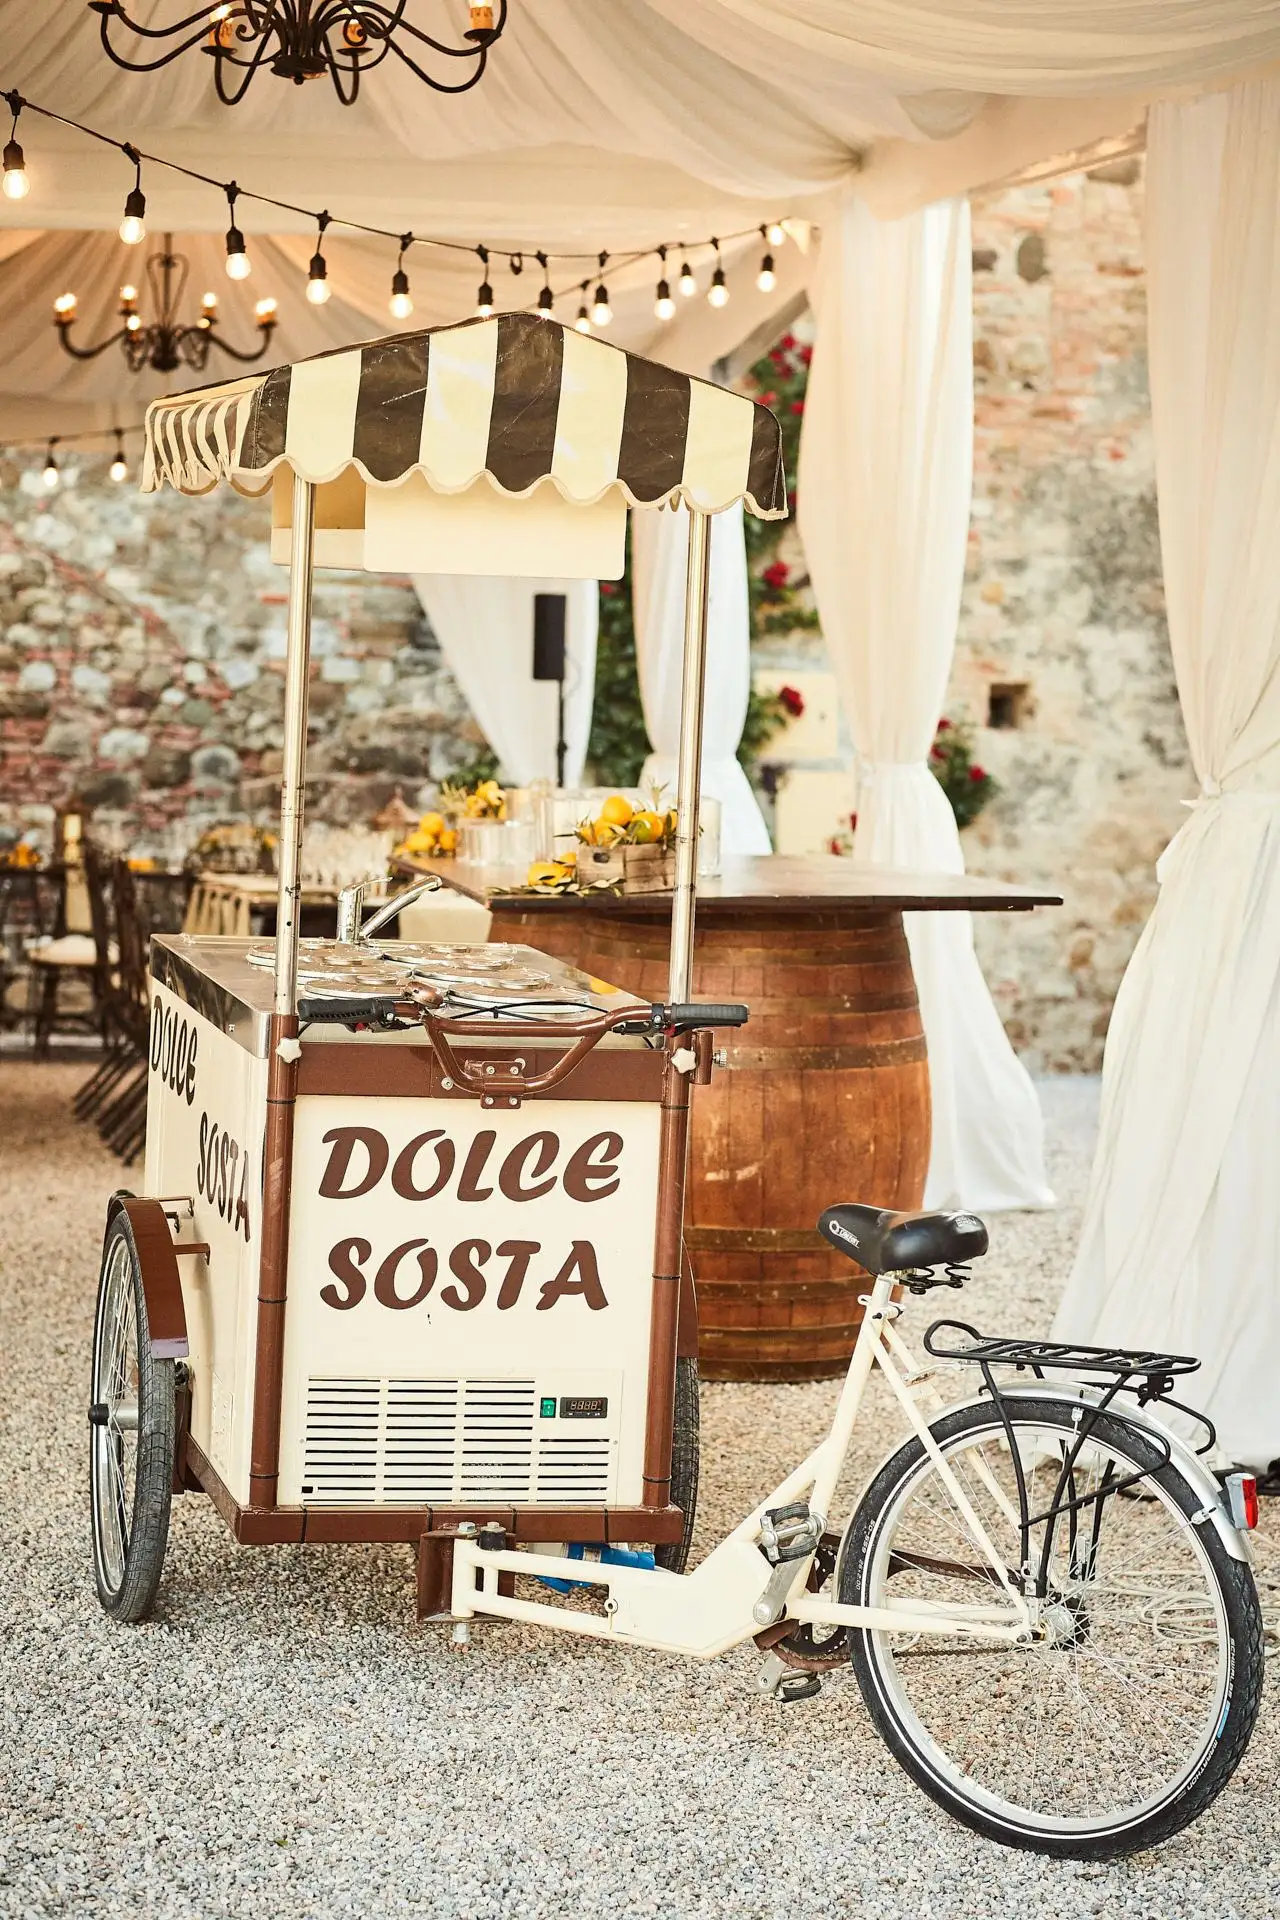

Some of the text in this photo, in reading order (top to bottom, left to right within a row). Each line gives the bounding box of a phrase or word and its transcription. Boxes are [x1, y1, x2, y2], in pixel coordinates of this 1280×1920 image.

[151, 995, 198, 1106] DOLCE
[197, 1112, 250, 1242] SOSTA
[319, 1127, 624, 1203] DOLCE
[320, 1237, 610, 1311] SOSTA
[1187, 1740, 1218, 1790] MARATHON
